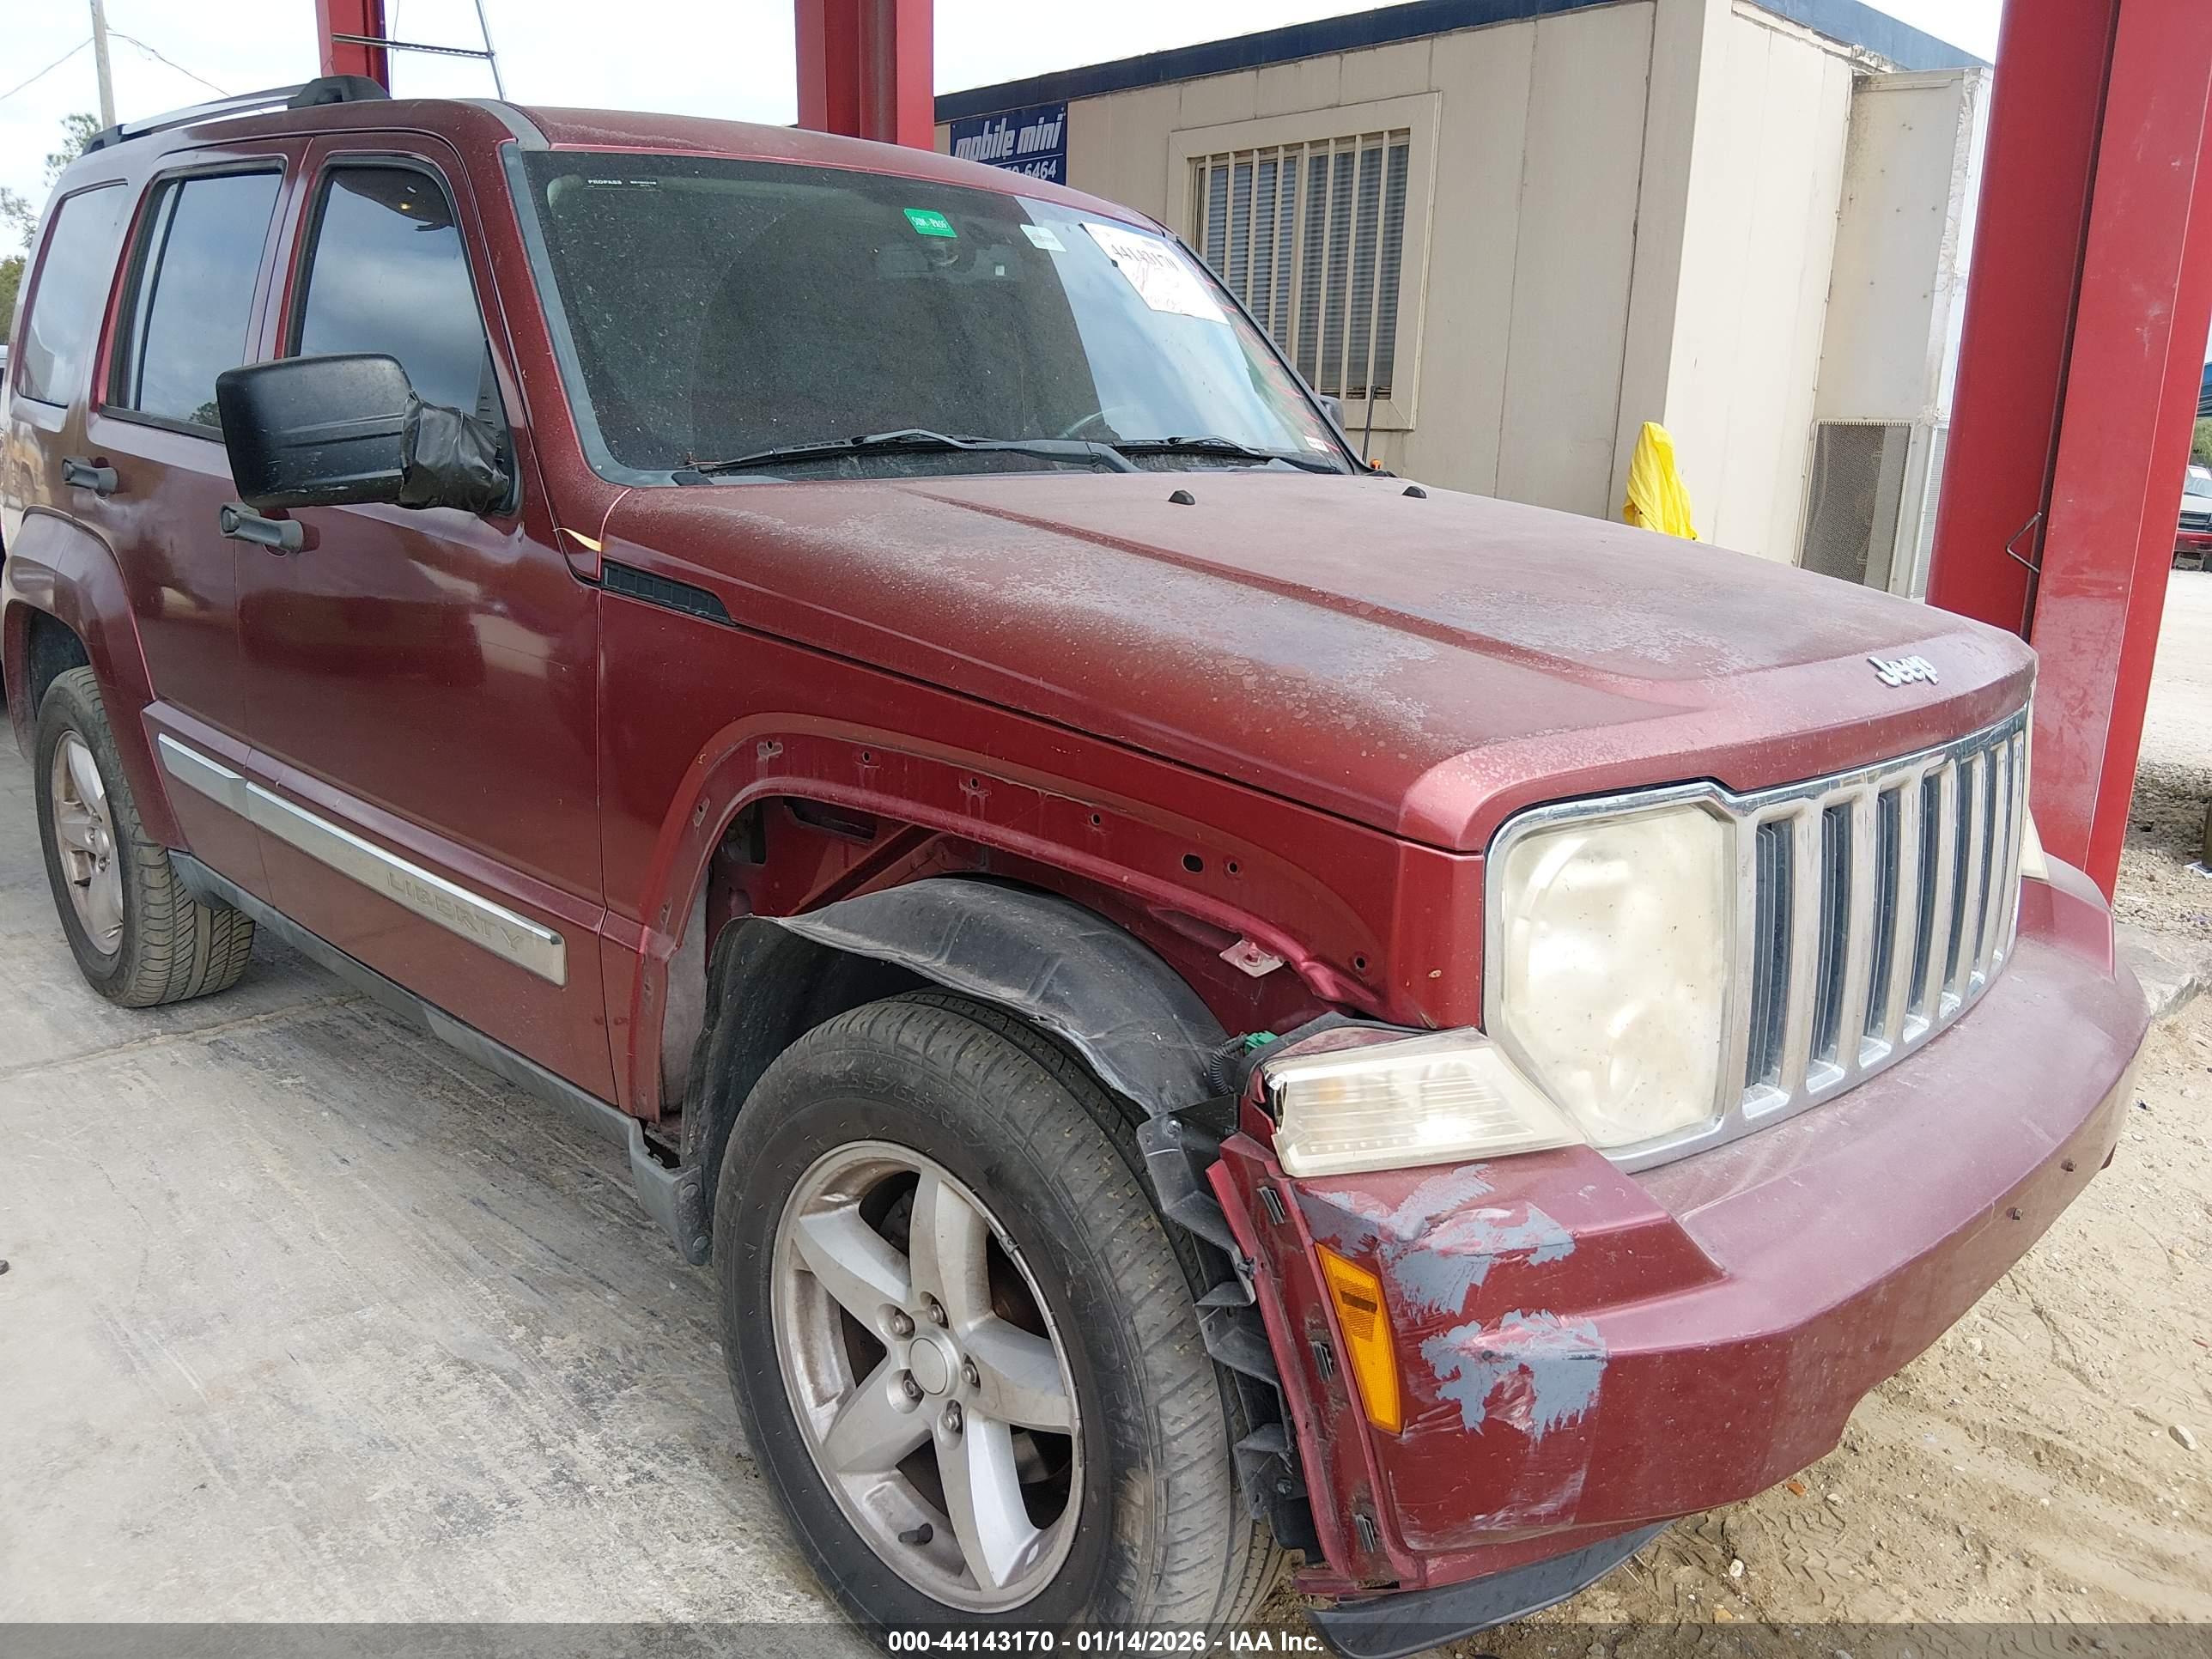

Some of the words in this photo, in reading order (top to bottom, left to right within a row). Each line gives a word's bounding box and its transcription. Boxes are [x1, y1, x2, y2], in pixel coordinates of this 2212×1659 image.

[955, 118, 1016, 161] mobile
[1017, 113, 1064, 155] mini
[1866, 655, 1940, 688] Jeep
[386, 872, 525, 951] LIBERTY
